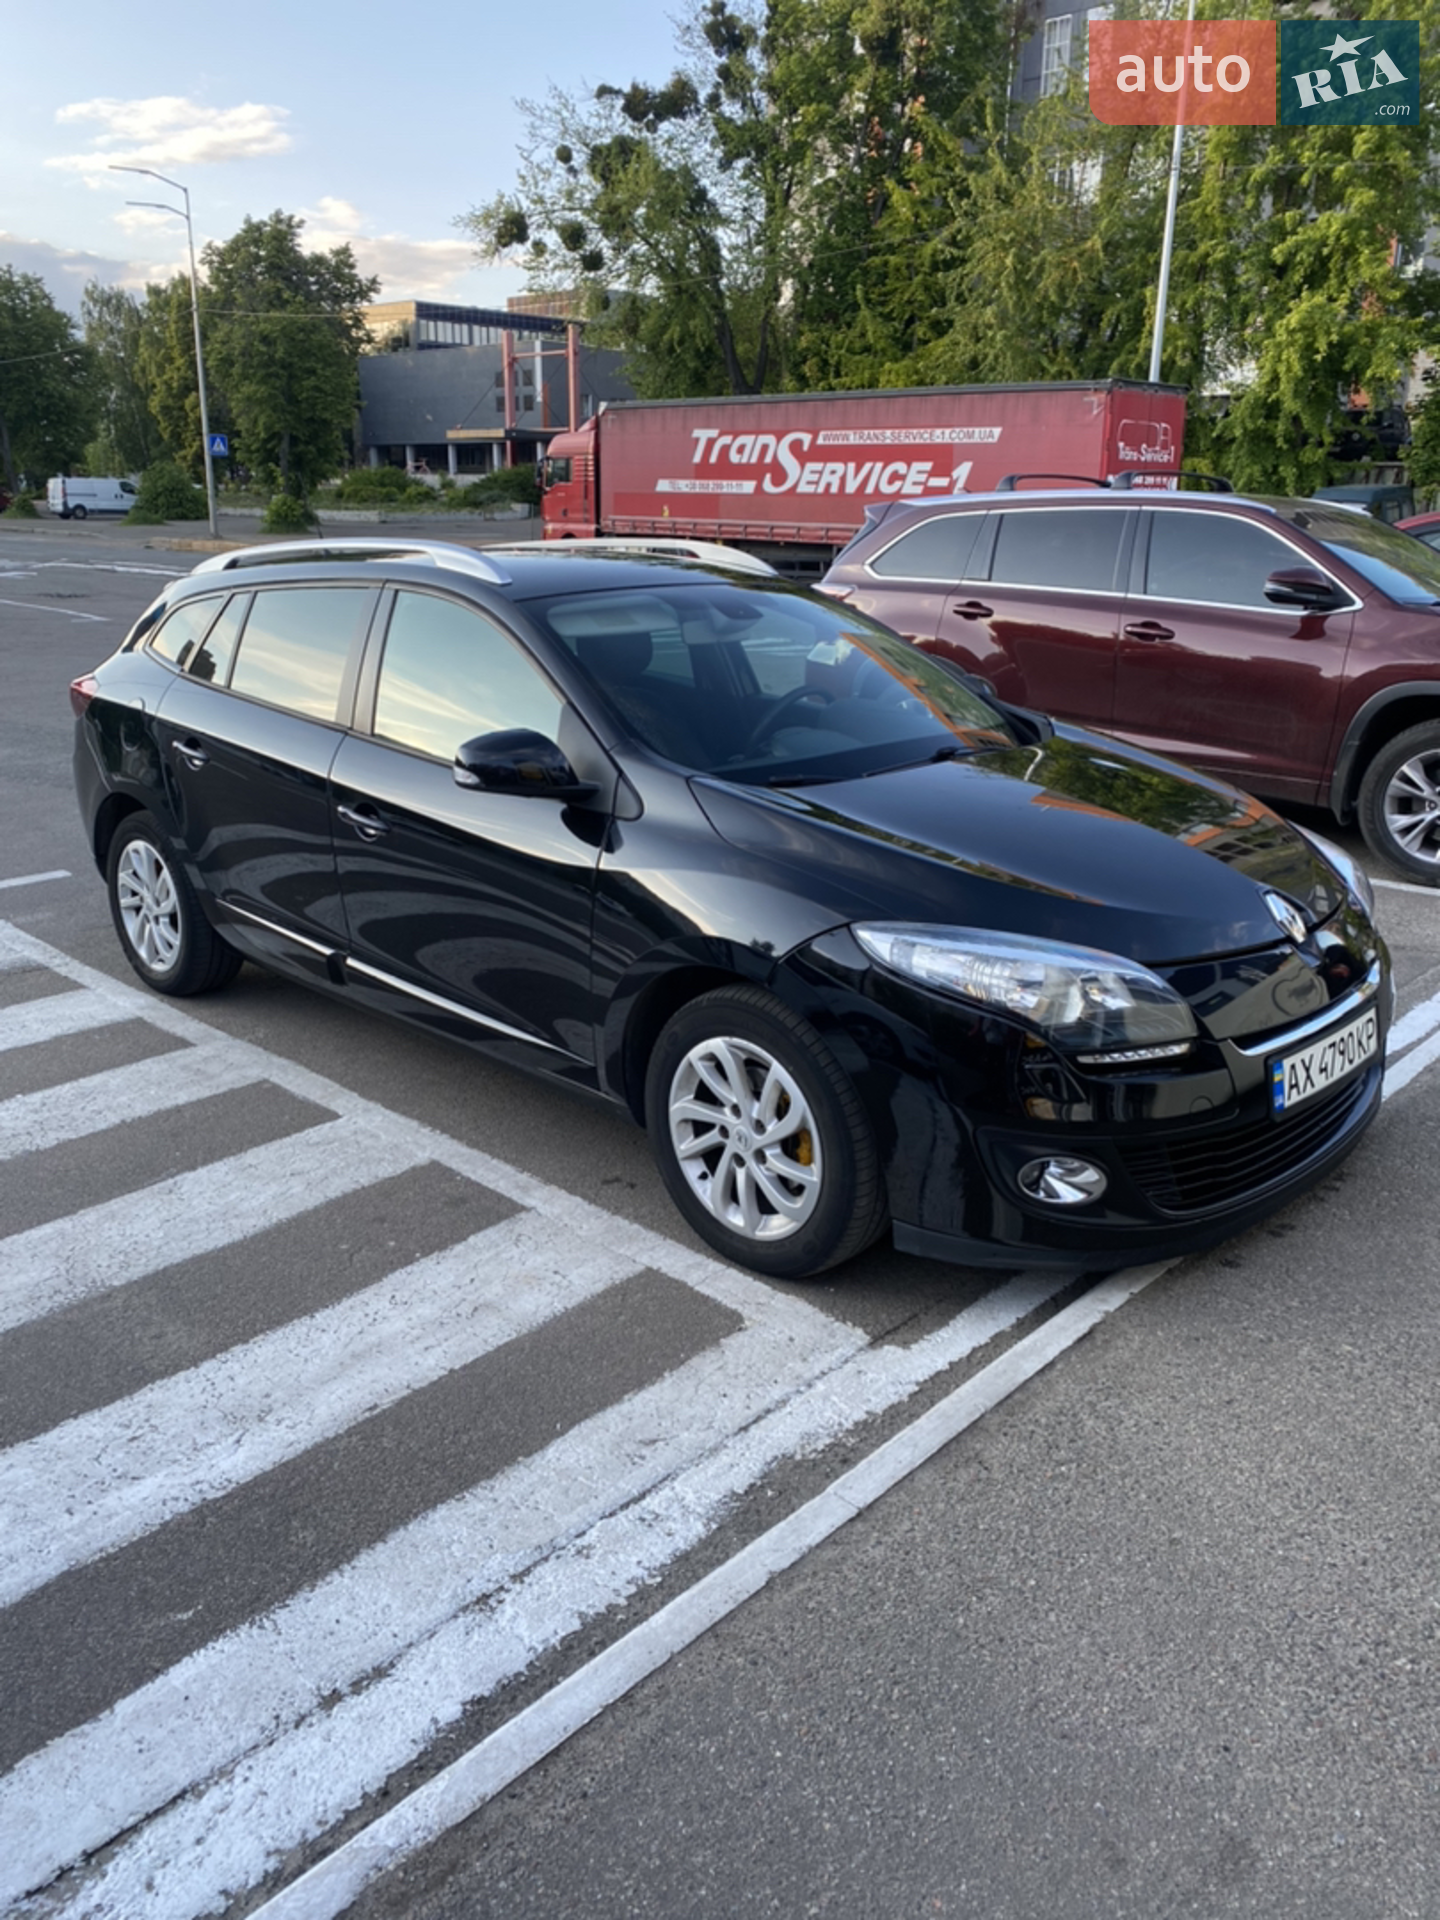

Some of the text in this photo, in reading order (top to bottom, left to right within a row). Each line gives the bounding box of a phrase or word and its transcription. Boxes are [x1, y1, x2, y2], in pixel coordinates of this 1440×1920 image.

[822, 428, 996, 443] WWW.TRANS-SERVICE-1.COM.UA
[1287, 1018, 1375, 1100] AX 4790 KP
